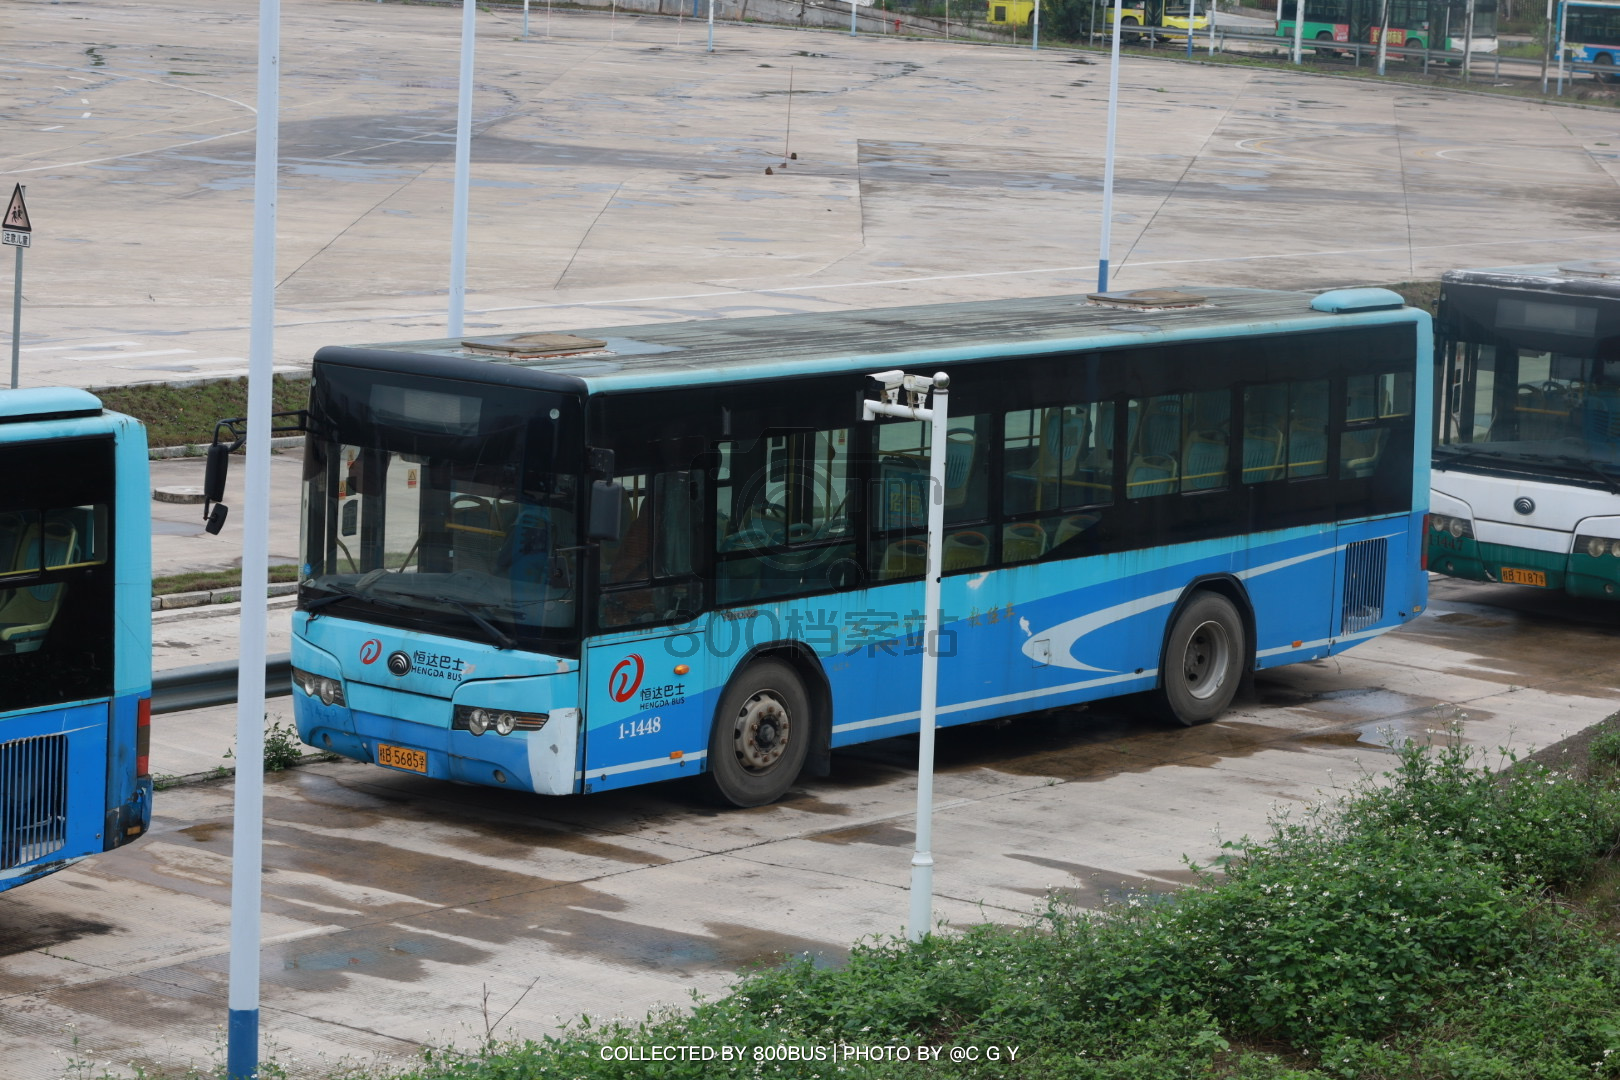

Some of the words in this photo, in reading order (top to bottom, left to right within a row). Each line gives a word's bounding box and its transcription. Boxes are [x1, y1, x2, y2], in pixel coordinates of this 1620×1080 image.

[4, 231, 28, 246] 注意儿童
[413, 650, 464, 671] 恒达巴士
[411, 665, 444, 679] HENGDA
[447, 671, 462, 682] BUS
[640, 683, 685, 701] 恒达巴士
[640, 699, 669, 710] HENGDA
[671, 696, 685, 706] BUS
[618, 716, 661, 739] 1-1448
